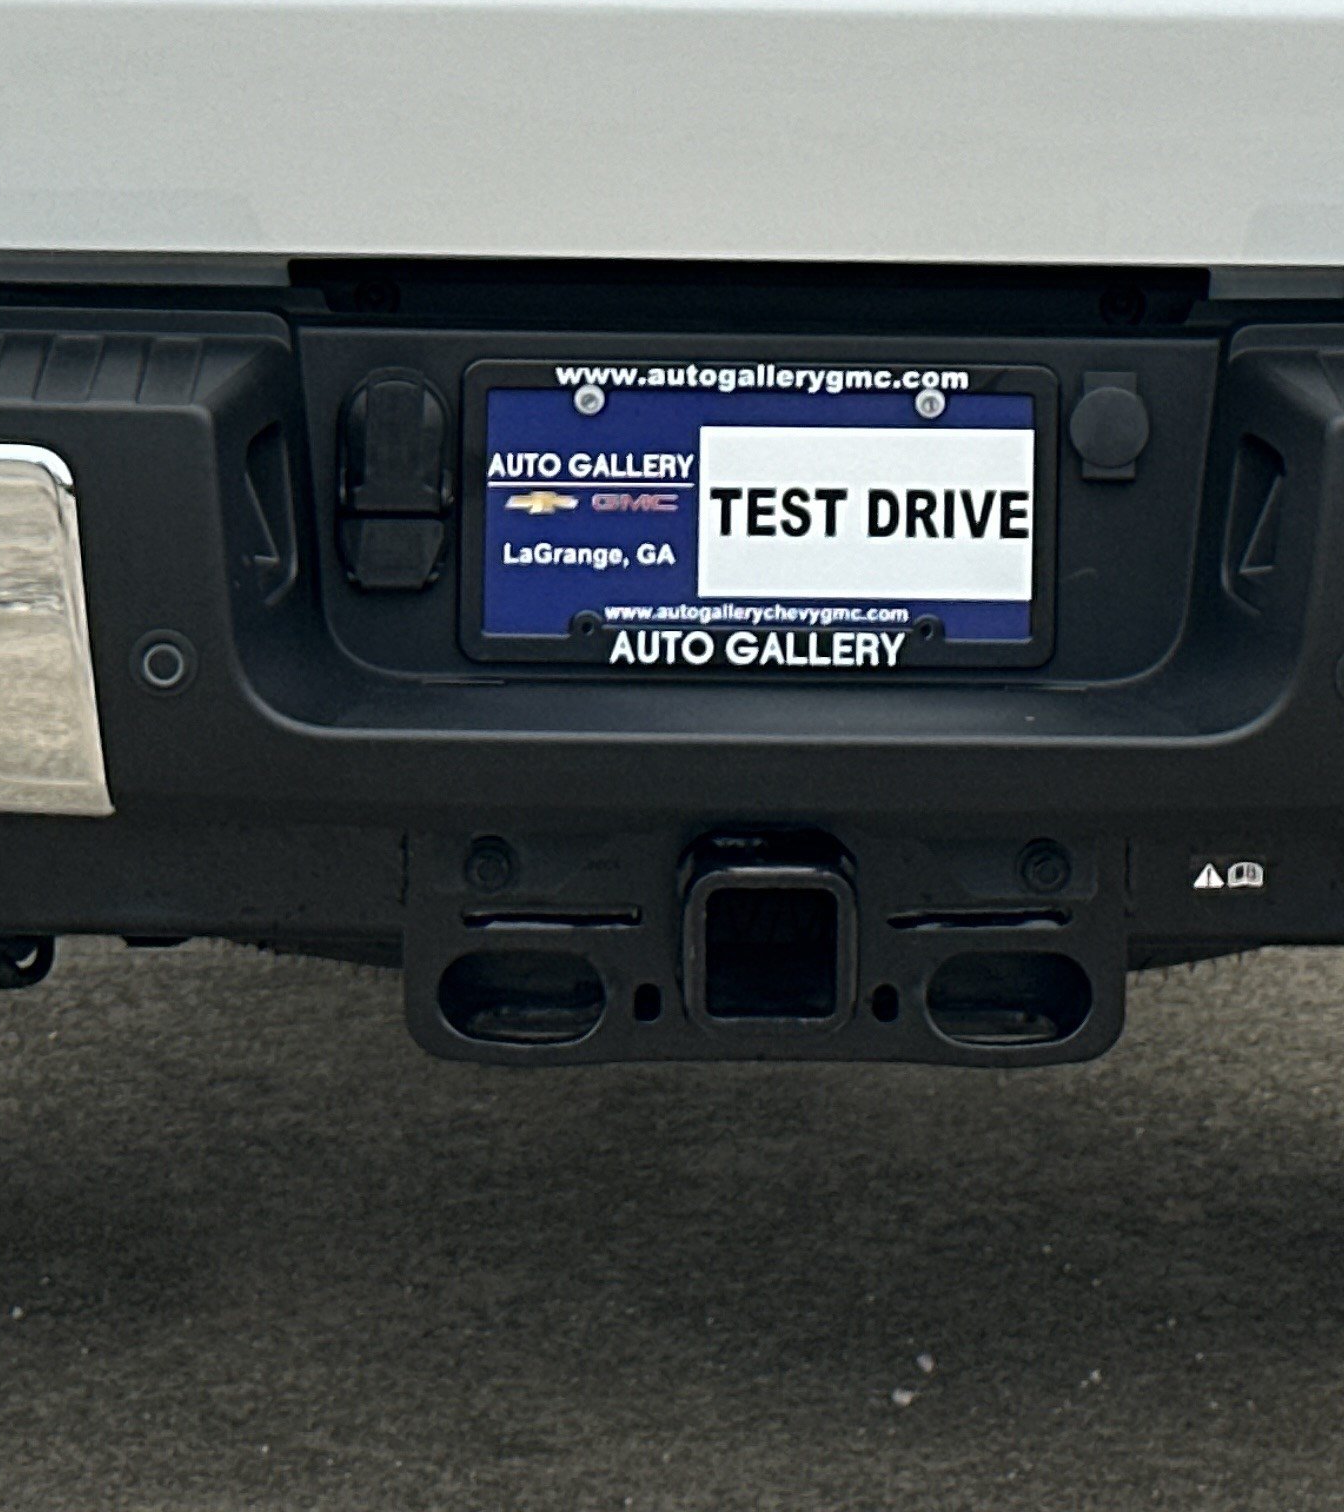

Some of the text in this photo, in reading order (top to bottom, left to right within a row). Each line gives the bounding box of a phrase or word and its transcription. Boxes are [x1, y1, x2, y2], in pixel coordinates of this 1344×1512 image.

[555, 363, 969, 394] www.autogallerygmc.com
[487, 452, 695, 479] AUTO GALLERY
[590, 492, 680, 512] GMC
[709, 486, 1030, 540] TEST DRIVE
[503, 541, 677, 570] LaGrange, GA
[605, 603, 910, 626] www.autogallerychevygmc.com
[609, 629, 906, 667] AUTO GALLERY
